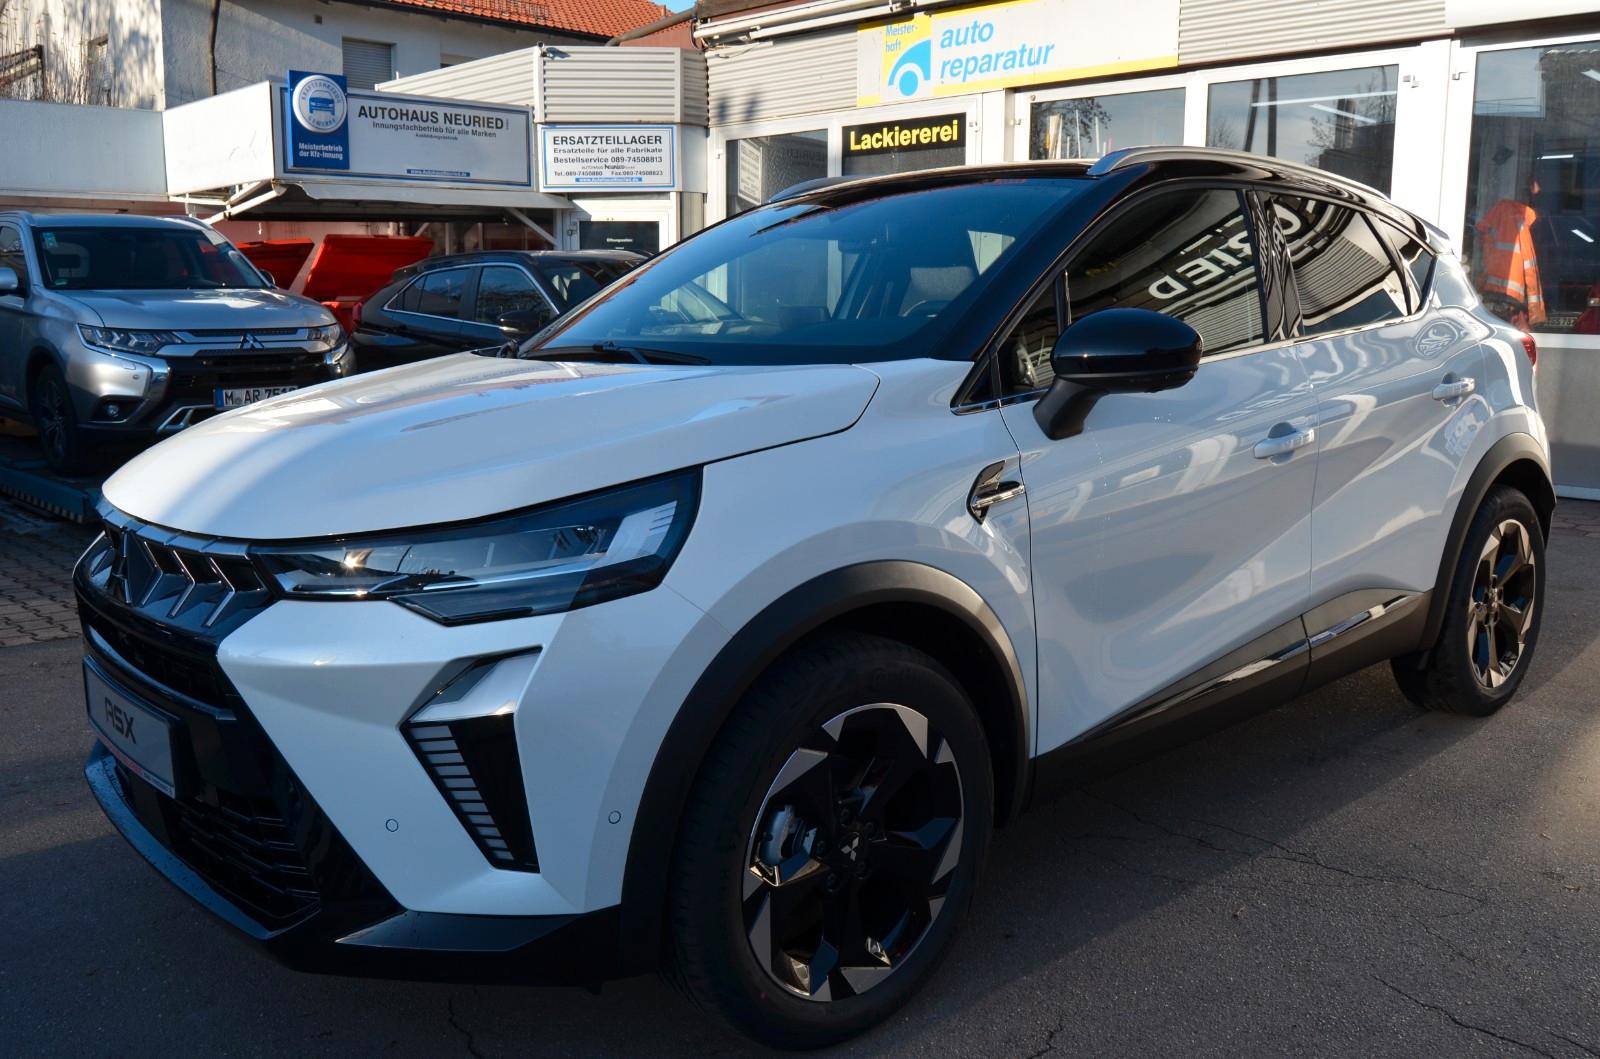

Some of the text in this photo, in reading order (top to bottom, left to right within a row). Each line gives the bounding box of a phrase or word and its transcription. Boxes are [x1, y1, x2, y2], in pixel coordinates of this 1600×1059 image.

[886, 24, 918, 36] Meister-
[940, 20, 994, 48] auto
[941, 43, 1055, 82] reparatur
[358, 105, 439, 124] AUTOHAUS
[443, 112, 504, 130] NEURIED
[372, 121, 497, 138] Innungsfachbetrieb für alle Marken
[850, 119, 958, 151] Lackiererei
[298, 143, 342, 153] Meisterbetrieb
[553, 135, 662, 146] ERSATZTEILLAGER
[299, 150, 343, 160] der Kfz-Innung
[626, 146, 663, 154] Fabrikate
[553, 156, 663, 164] Bestellservice 089-74508813
[225, 391, 234, 405] M
[244, 390, 261, 404] AR
[104, 696, 137, 745] RSX
